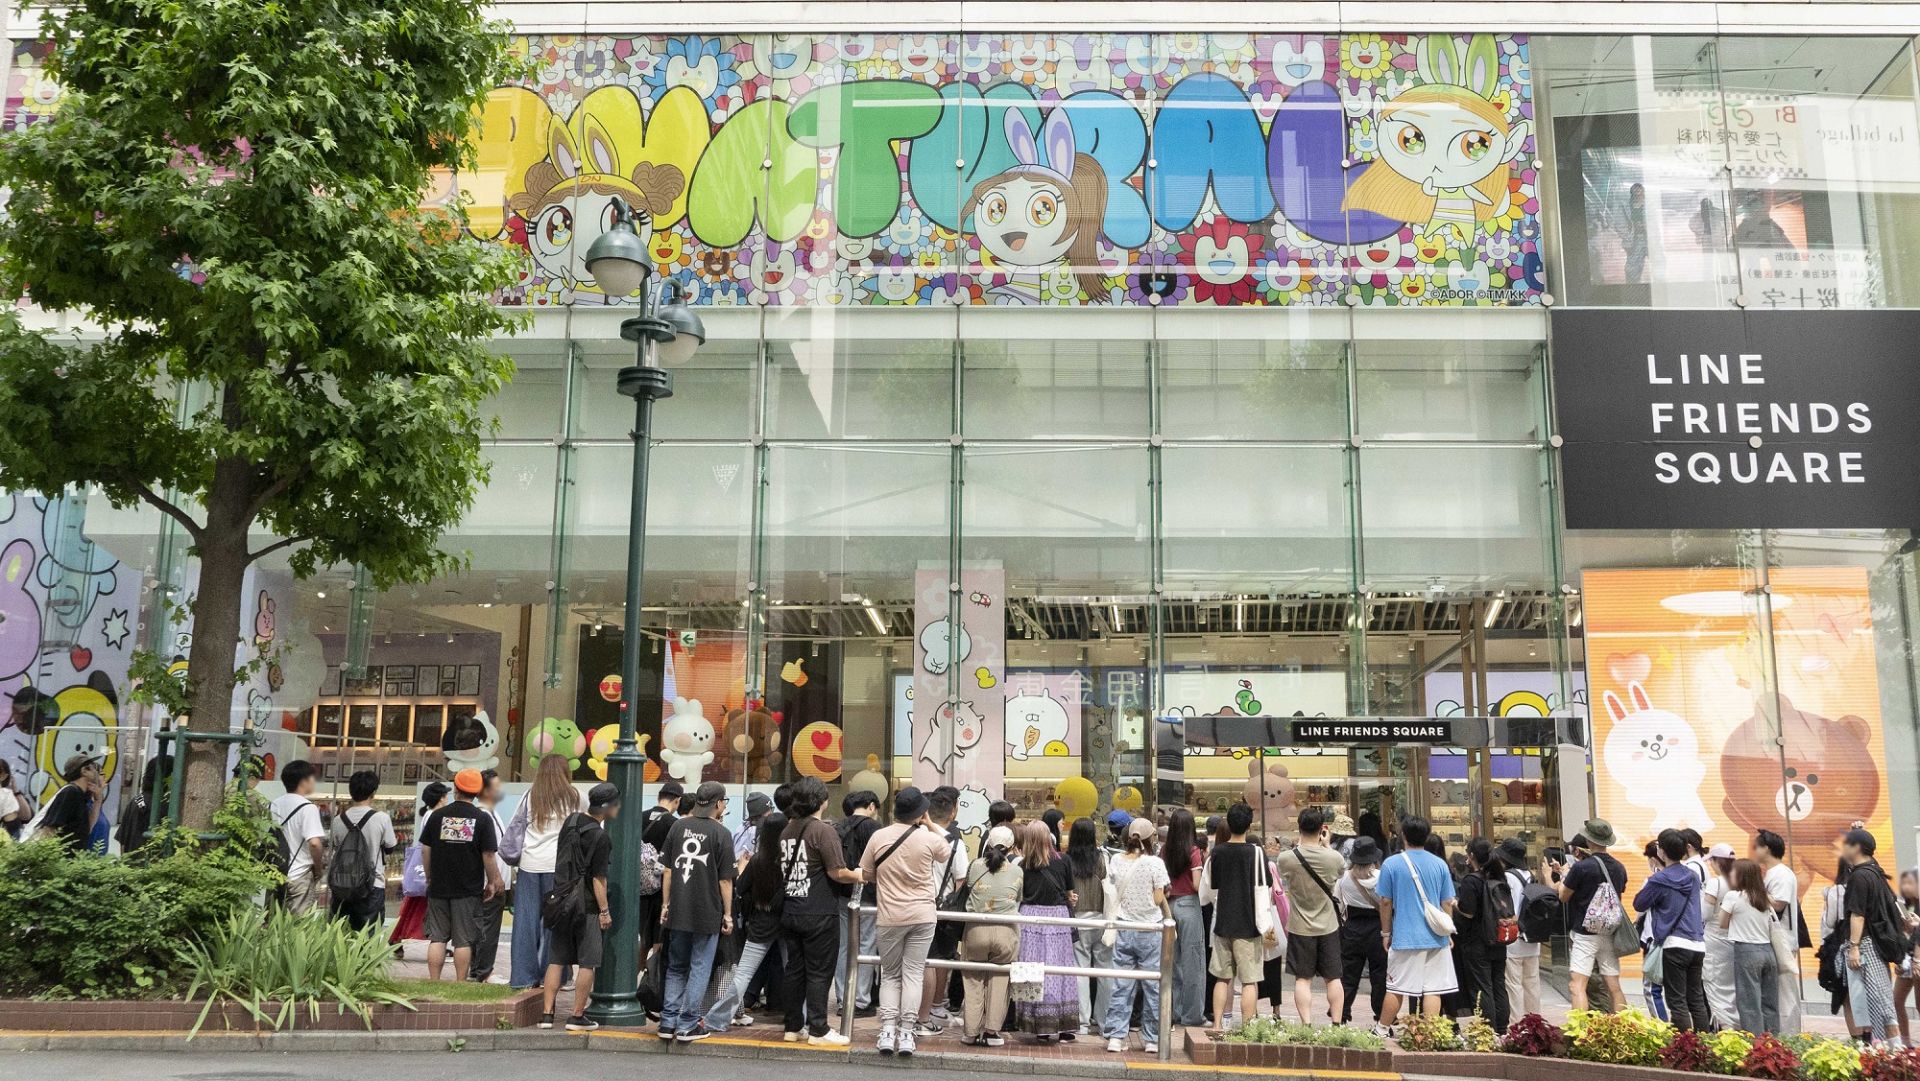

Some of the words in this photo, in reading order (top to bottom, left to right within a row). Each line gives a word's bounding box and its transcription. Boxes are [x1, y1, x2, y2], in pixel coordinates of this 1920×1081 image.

[1430, 290, 1474, 299] ©ADOR
[1647, 354, 1765, 385] LINE
[1651, 402, 1872, 433] FRIENDS
[1654, 452, 1865, 485] SQUARE
[1300, 726, 1330, 737] LINE
[1334, 726, 1388, 737] FRIENDS
[1393, 726, 1444, 737] SQUARE
[683, 828, 707, 842] liberty
